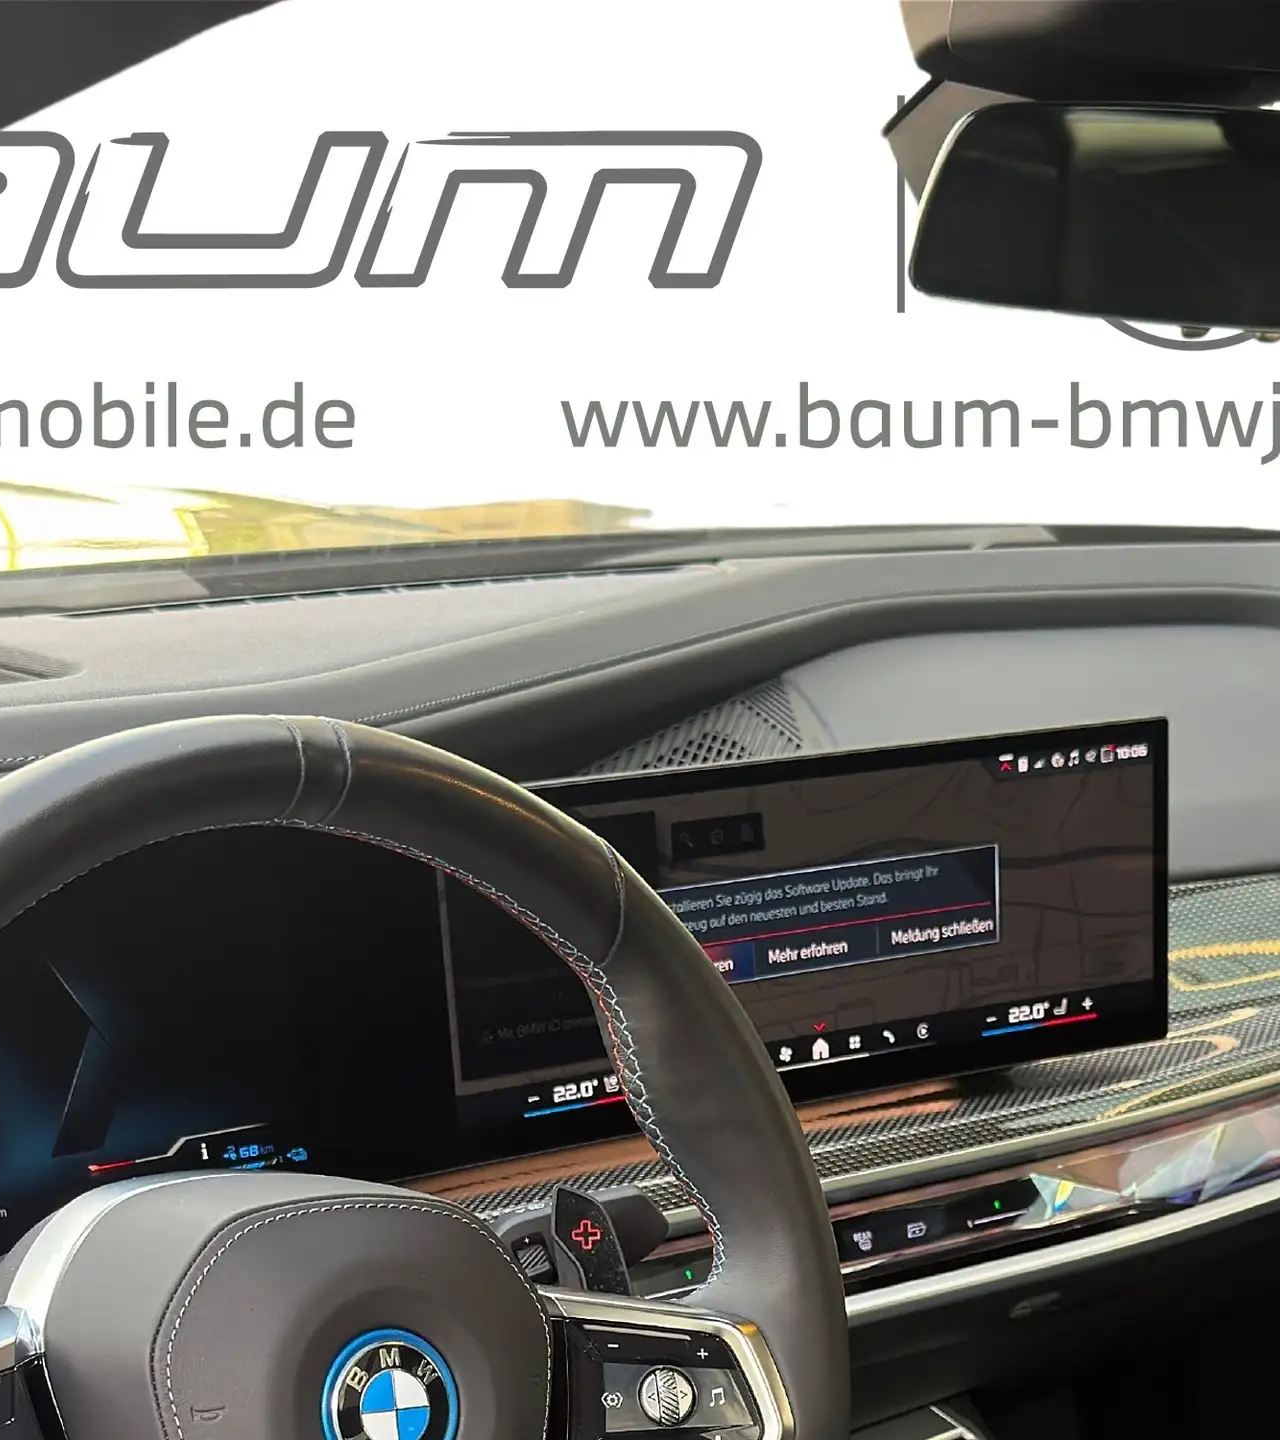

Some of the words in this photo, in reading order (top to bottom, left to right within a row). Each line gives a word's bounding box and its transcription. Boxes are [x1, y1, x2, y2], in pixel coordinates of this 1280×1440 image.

[716, 894, 733, 908] Sie
[764, 888, 783, 901] das
[784, 882, 830, 898] Software
[873, 871, 893, 886] Das
[894, 866, 924, 883] bringt
[709, 913, 726, 929] auf
[727, 911, 748, 926] den
[749, 906, 797, 922] neuesten
[799, 901, 819, 915] und
[820, 895, 855, 913] besten
[891, 926, 940, 945] Meldung
[941, 917, 994, 939] schließen
[768, 947, 798, 965] Mehr
[800, 940, 848, 960] erfahren
[346, 1347, 438, 1393] BMW
